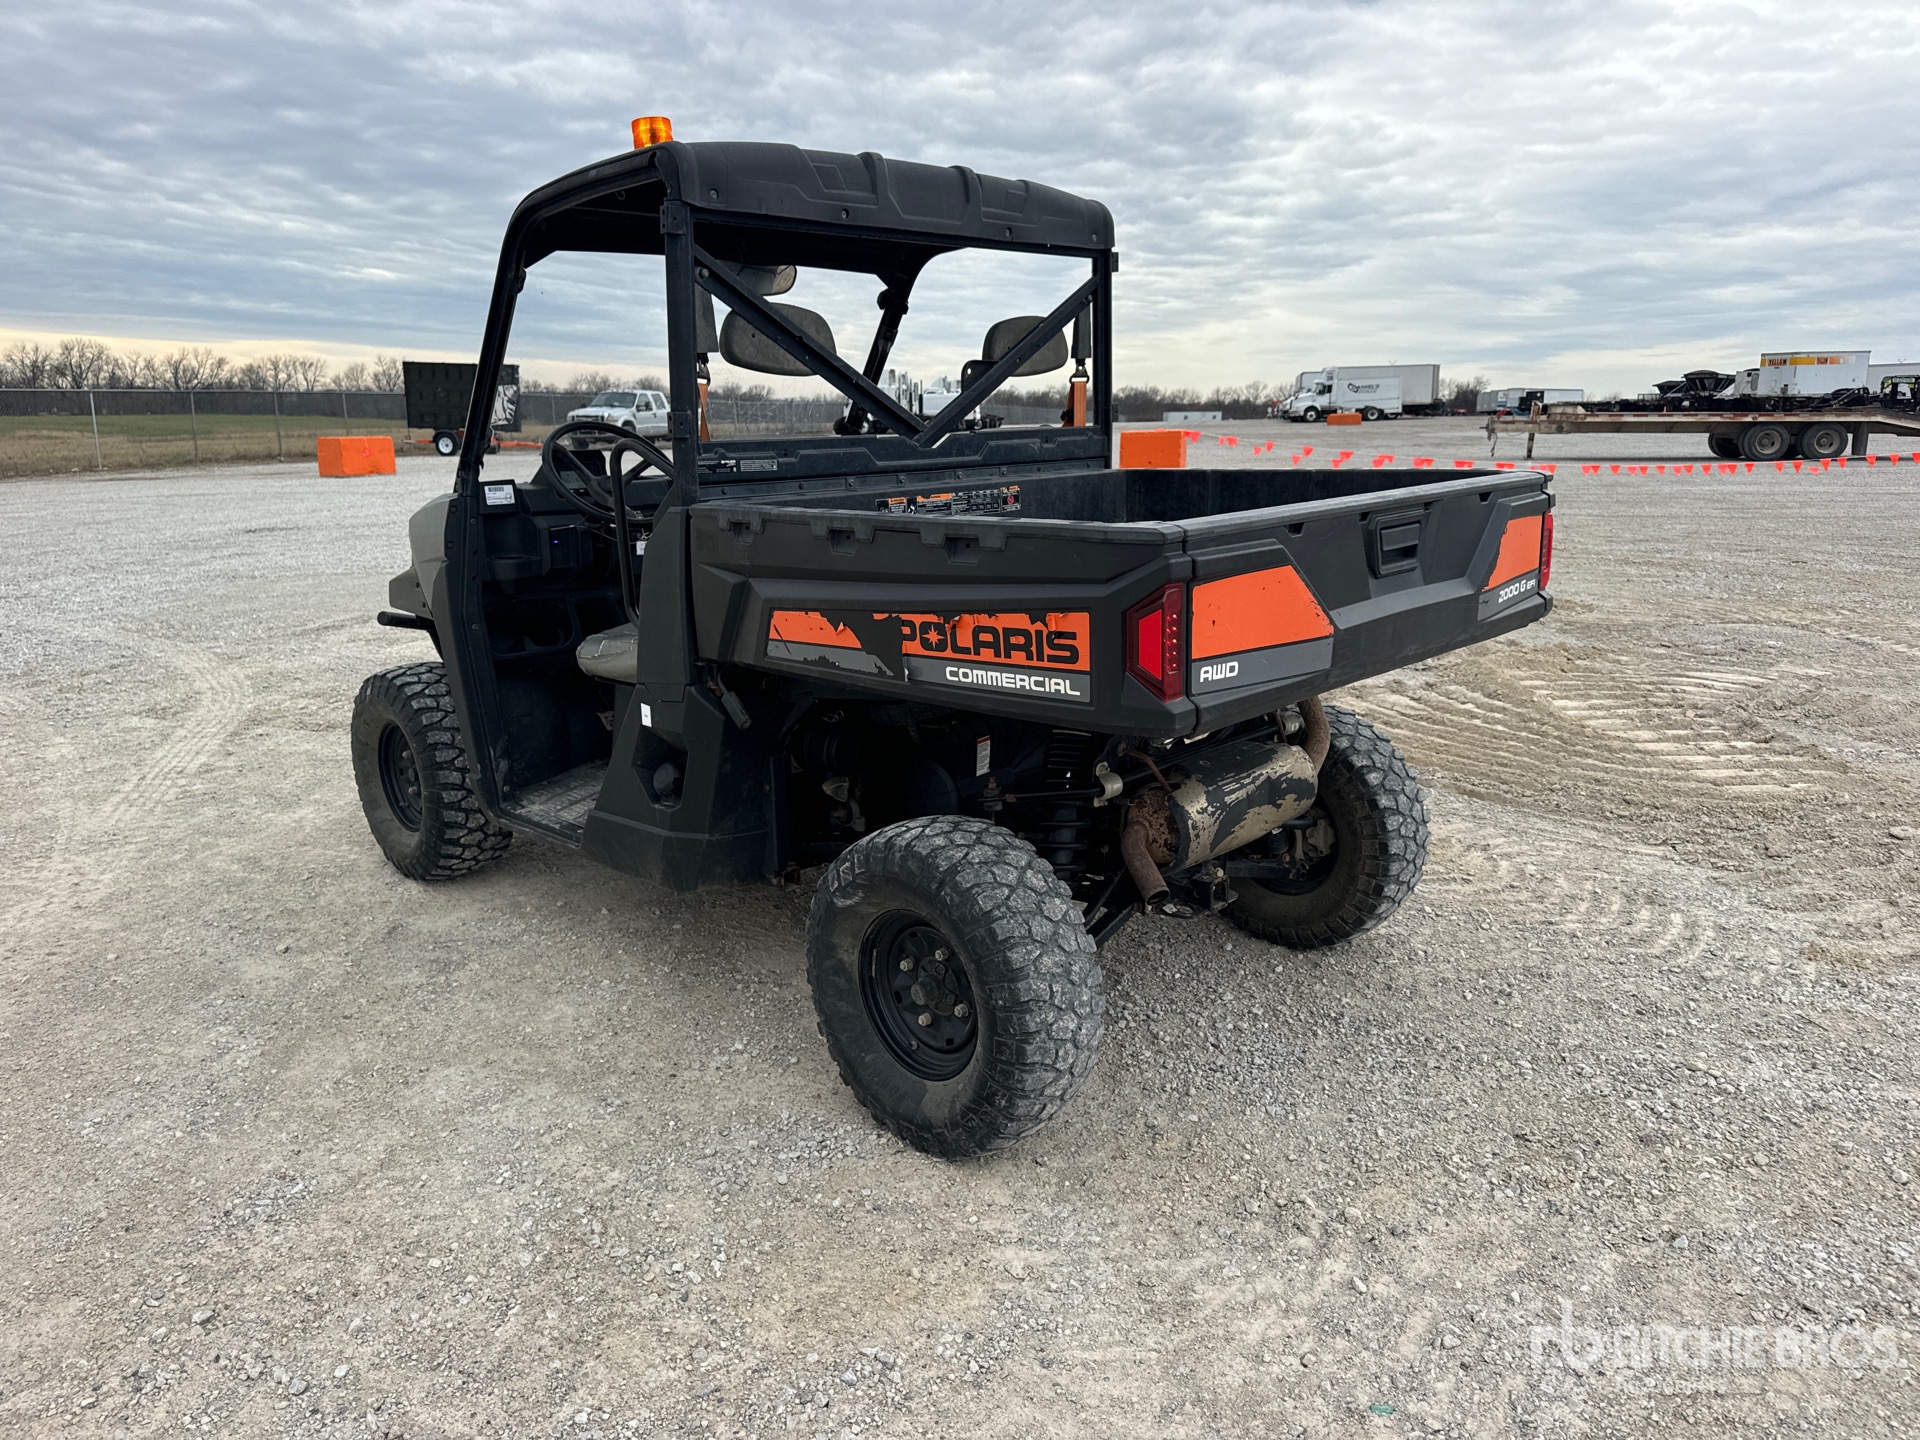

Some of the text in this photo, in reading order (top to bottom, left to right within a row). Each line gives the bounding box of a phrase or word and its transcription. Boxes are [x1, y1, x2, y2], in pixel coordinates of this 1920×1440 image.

[1498, 582, 1520, 603] 2000
[1520, 579, 1527, 593] G
[902, 619, 1080, 665] POLARIS
[945, 666, 1081, 696] COMMERCIAL
[1199, 661, 1239, 683] AWD
